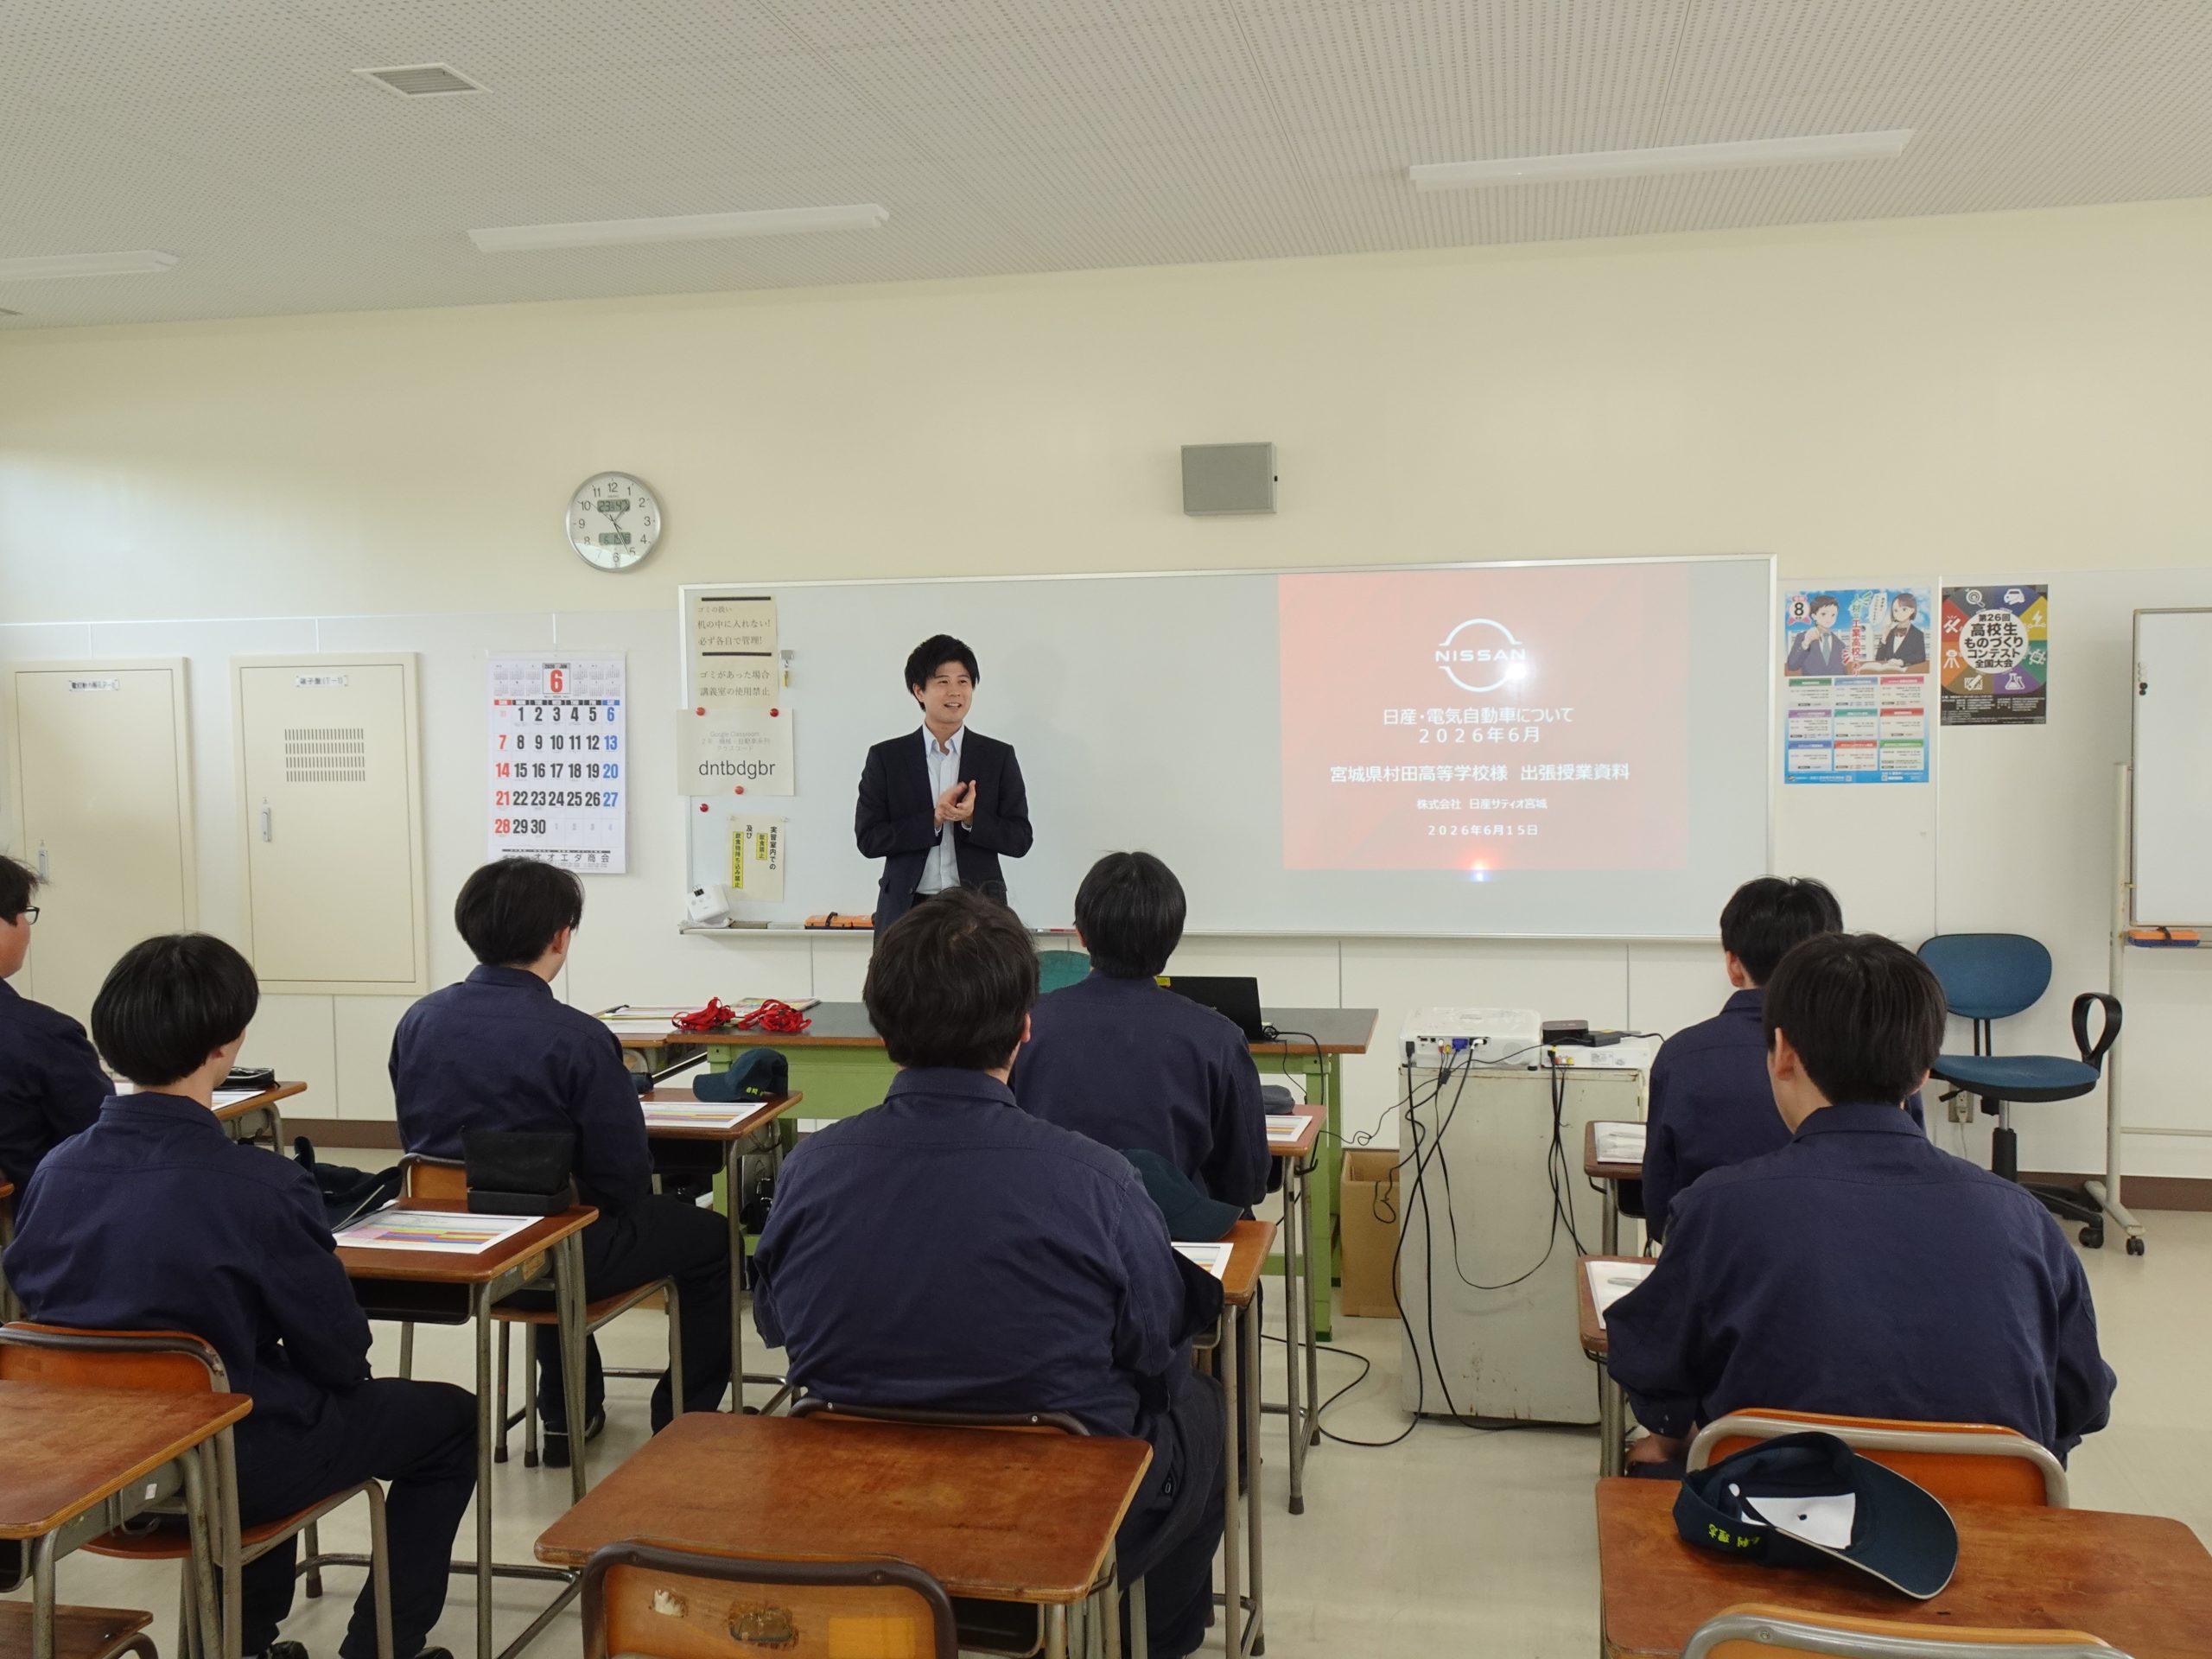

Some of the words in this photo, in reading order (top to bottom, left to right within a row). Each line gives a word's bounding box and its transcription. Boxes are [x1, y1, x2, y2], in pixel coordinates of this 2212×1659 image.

[593, 488, 601, 498] 11
[608, 482, 618, 493] 12
[581, 500, 591, 511] 10
[639, 498, 645, 507] 2
[579, 518, 585, 529] 9
[644, 516, 651, 526] 3
[584, 536, 590, 545] 8
[640, 534, 647, 544] 4
[613, 552, 620, 563] 6
[1795, 602, 1803, 616] 8
[1979, 613, 2011, 622] 第26回
[1971, 623, 2018, 637] 高校生
[1964, 638, 2023, 649] ものづくり
[1435, 649, 1526, 662] NISSAN
[1967, 648, 2020, 658] コンテスト
[1975, 659, 2013, 669] 全国大会
[550, 670, 563, 693] 6
[518, 707, 524, 721] 1
[535, 707, 543, 721] 2
[553, 707, 561, 721] 3
[570, 707, 579, 721] 4
[589, 707, 596, 721] 5
[607, 707, 614, 721] 6
[1382, 707, 1573, 725] 日産・電気自動車について
[499, 734, 507, 750] 7
[517, 734, 524, 750] 8
[535, 734, 543, 750] 9
[550, 734, 563, 750] 10
[569, 734, 581, 750] 11
[586, 734, 600, 750] 12
[604, 734, 618, 750] 13
[1418, 727, 1541, 744] 2026年6月
[496, 763, 510, 779] 14
[514, 763, 527, 779] 15
[532, 763, 545, 779] 16
[550, 763, 563, 779] 17
[569, 763, 582, 779] 18
[587, 763, 600, 779] 19
[603, 763, 619, 779] 20
[699, 760, 775, 779] dntbdgbr
[1330, 764, 1508, 783] 宮城県村田高等学校様
[1521, 763, 1630, 781] 出張授業資料
[496, 791, 510, 806] 21
[513, 791, 528, 806] 22
[531, 791, 546, 806] 23
[549, 791, 564, 806] 24
[567, 791, 582, 806] 25
[585, 791, 601, 806] 26
[603, 791, 618, 806] 27
[1417, 798, 1461, 810] 株式会社
[1469, 798, 1548, 810] 日産サティオ宮城
[495, 818, 510, 834] 28
[513, 819, 528, 834] 29
[531, 819, 546, 834] 30
[746, 824, 753, 839] 及び
[1427, 823, 1538, 836] 2026年6月15日
